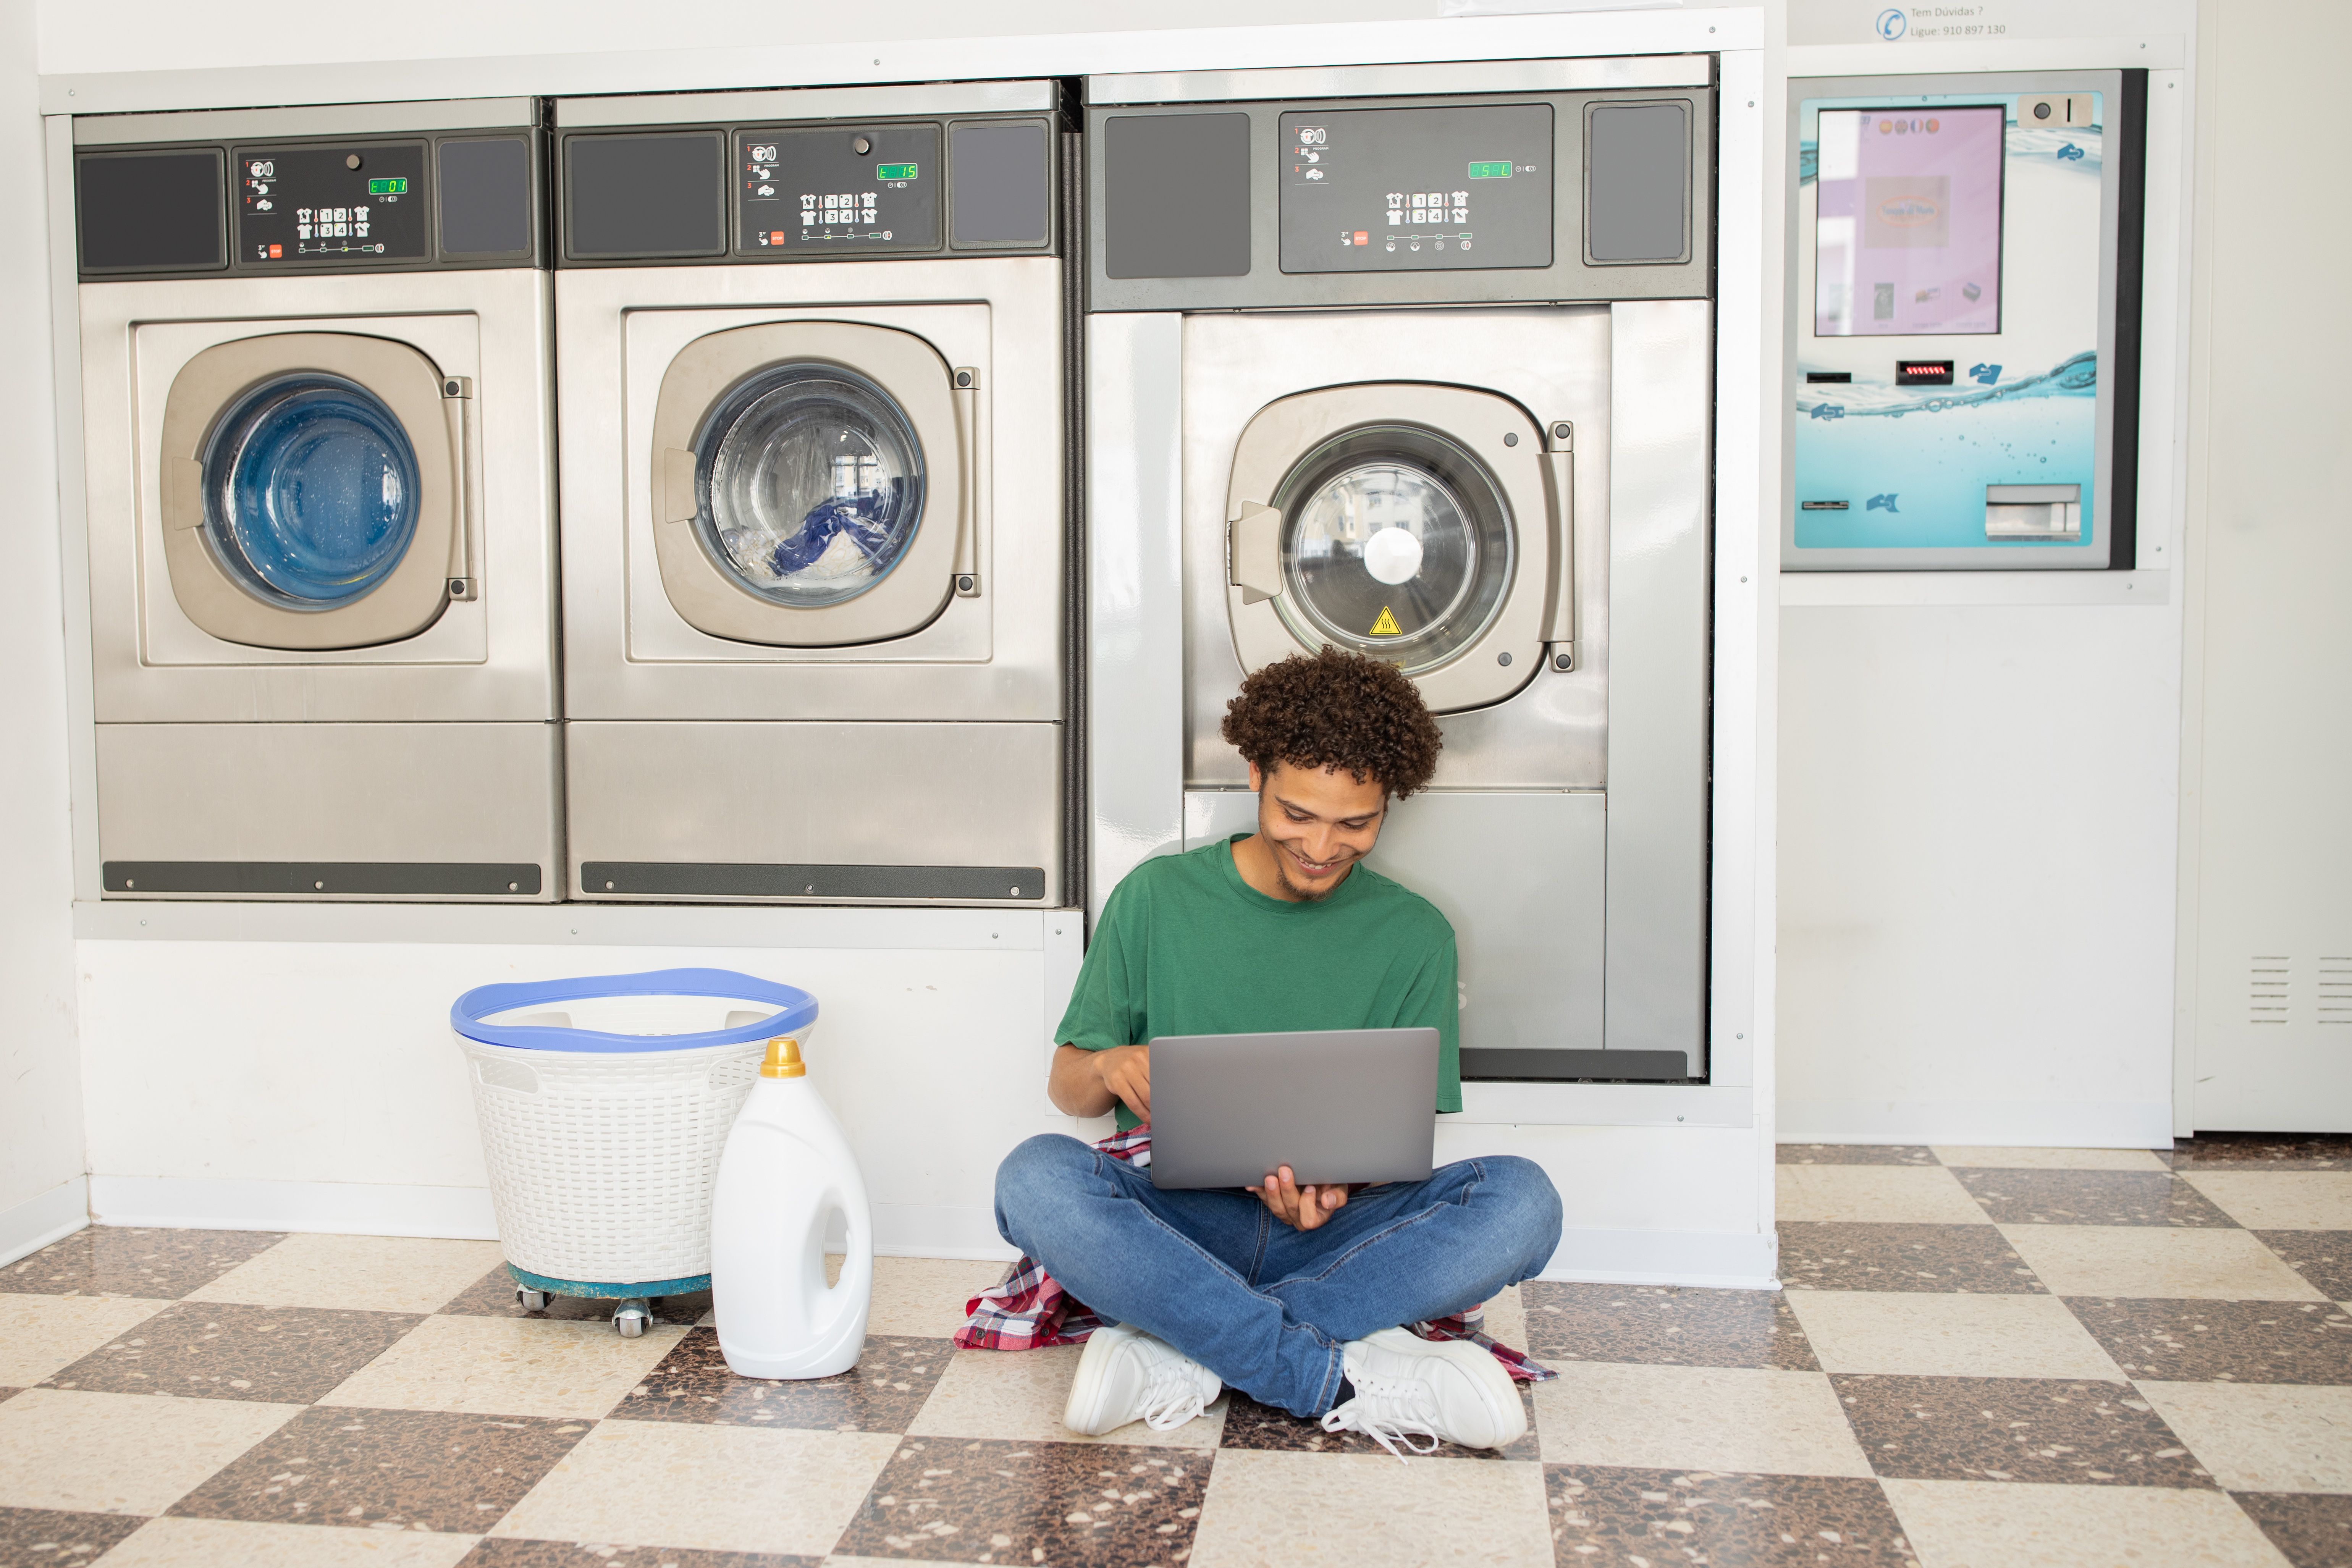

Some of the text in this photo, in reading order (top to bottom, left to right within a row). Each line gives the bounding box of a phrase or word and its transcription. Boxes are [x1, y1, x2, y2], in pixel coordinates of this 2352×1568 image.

[1911, 6, 1983, 17] Tem Dúvidas ?
[1911, 25, 2006, 38] Ligue: 910 897 130
[903, 166, 915, 177] 15
[389, 180, 405, 192] 01
